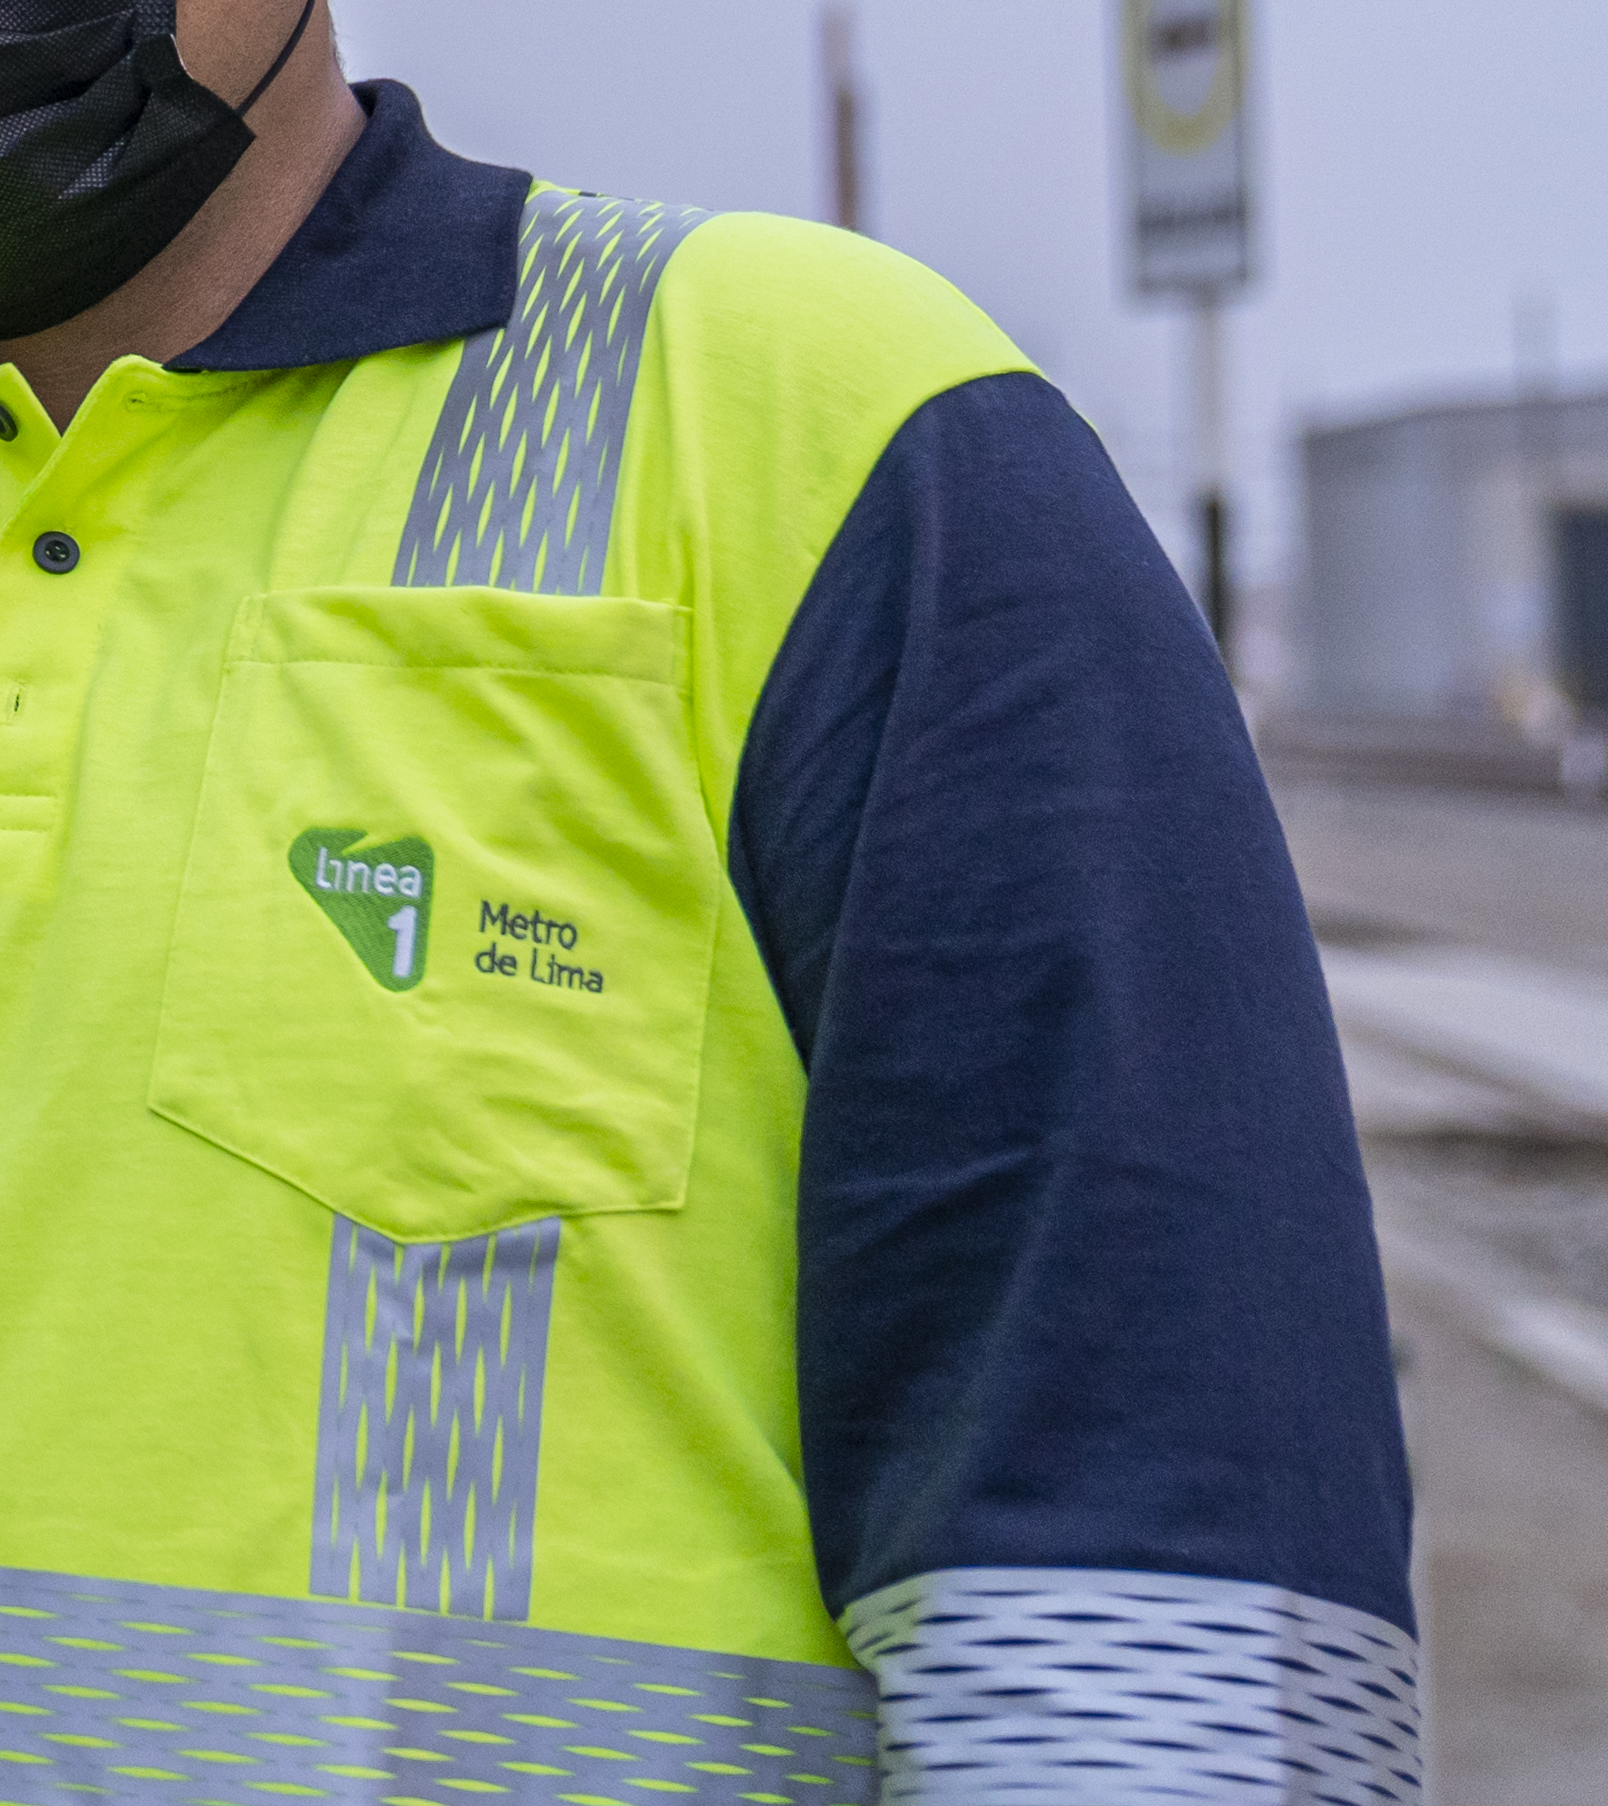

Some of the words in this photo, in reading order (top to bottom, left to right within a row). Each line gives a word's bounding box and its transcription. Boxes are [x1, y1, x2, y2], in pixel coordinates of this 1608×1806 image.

[386, 904, 419, 980] 1
[478, 899, 578, 951] Metro
[474, 943, 518, 977] de
[530, 948, 605, 994] Lima
